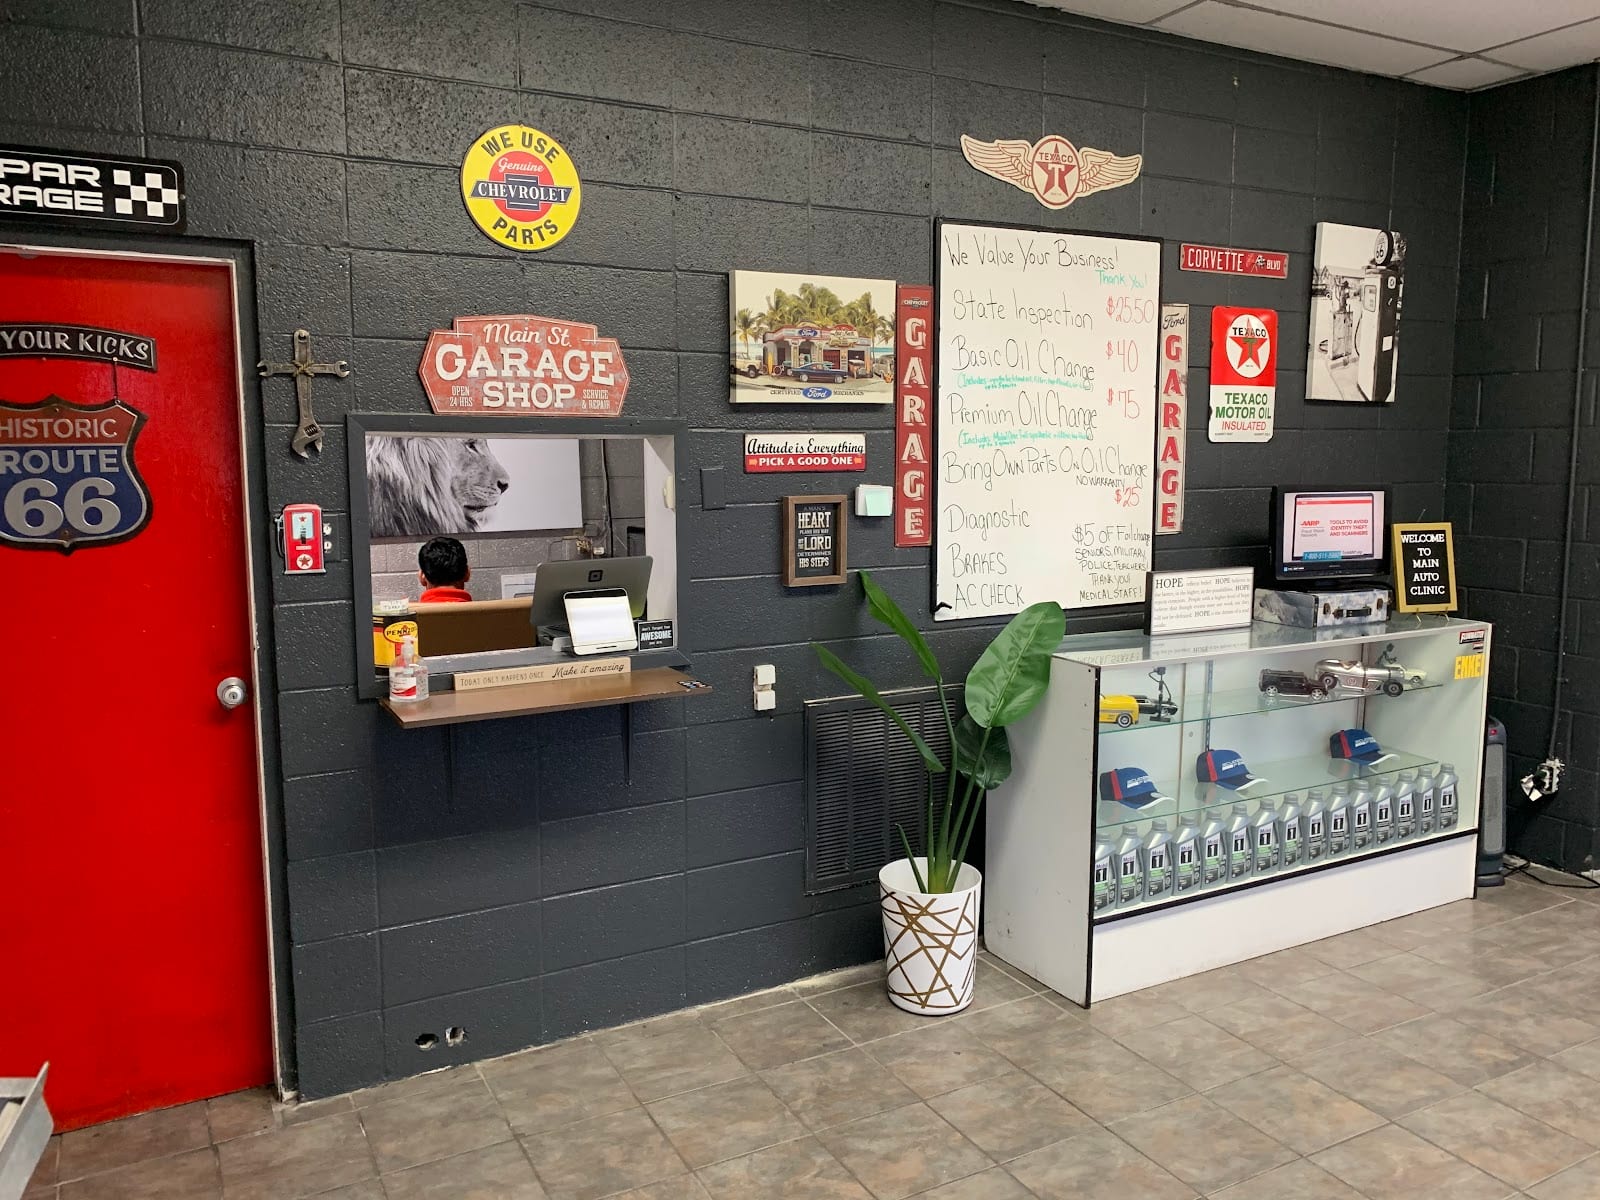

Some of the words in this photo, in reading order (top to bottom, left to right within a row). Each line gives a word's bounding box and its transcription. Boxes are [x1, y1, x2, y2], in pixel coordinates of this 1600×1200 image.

[481, 131, 514, 157] WE
[521, 131, 560, 164] USE
[498, 157, 545, 173] Genuine
[1039, 152, 1074, 163] TEXACO
[478, 182, 567, 202] CHEVROLET
[492, 216, 559, 245] PARTS
[945, 233, 969, 267] We
[973, 233, 1014, 265] Value
[1017, 237, 1050, 272] Your
[1053, 238, 1119, 270] Business!
[1188, 248, 1244, 272] CORVETTE
[1266, 260, 1281, 271] BLVD
[1095, 269, 1125, 286] Thank
[953, 289, 1005, 321] State
[1012, 288, 1093, 334] Inspection
[1163, 312, 1186, 330] Ford
[483, 323, 542, 345] Main
[548, 327, 573, 348] St.
[1232, 327, 1267, 338] TEXACO
[0, 331, 71, 350] YOUR
[79, 333, 150, 360] KICKS
[435, 343, 615, 386] GARAGE
[951, 334, 1002, 371] Basic
[1005, 338, 1030, 371] Oil
[1038, 339, 1095, 391] Change
[451, 385, 470, 396] OPEN
[482, 380, 576, 409] SHOP
[582, 389, 609, 400] SERVICE
[806, 387, 828, 399] Ford
[1224, 392, 1268, 405] TEXACO
[947, 392, 1014, 426] Premium
[1018, 390, 1042, 427] Oil
[1045, 389, 1098, 441] Change
[1215, 406, 1256, 419] MOTOR
[1258, 407, 1272, 419] OIL
[0, 418, 118, 439] HISTORIC
[901, 317, 929, 538] GARAGE
[1160, 334, 1183, 529] GARAGE
[1221, 421, 1267, 431] INSULATED
[748, 438, 793, 454] Attitude
[795, 443, 804, 454] is
[807, 438, 864, 454] Everything
[0, 450, 120, 474] ROUTE
[759, 457, 784, 467] PICK
[786, 457, 795, 466] A
[797, 457, 829, 466] GOOD
[831, 456, 853, 465] ONE
[943, 450, 992, 491] Bring
[1020, 446, 1058, 475] Parts
[1081, 446, 1103, 474] Oil
[1105, 444, 1148, 489] Change
[1075, 475, 1089, 486] NO
[1089, 477, 1126, 491] WARRANTY
[1114, 486, 1140, 507] $25
[4, 477, 121, 536] 66
[797, 511, 832, 529] HEART
[944, 499, 1030, 541] Diagnostic
[804, 535, 832, 550] LORD
[1072, 523, 1095, 547] $5
[1400, 533, 1445, 544] WELCOME
[946, 542, 1008, 578] BRAKES
[1417, 547, 1432, 557] TO
[798, 557, 810, 568] HIS
[810, 557, 830, 567] STEPS
[1412, 558, 1440, 568] MAIN
[1155, 577, 1184, 589] HOPE
[1412, 572, 1440, 582] AUTO
[955, 583, 977, 612] AC
[980, 583, 1025, 608] CHECK
[1079, 589, 1113, 602] MEDICAL
[1410, 585, 1446, 595] CLINIC
[640, 630, 672, 641] AWESOME
[460, 678, 481, 687] TODAY
[482, 676, 500, 685] ONLY
[551, 666, 578, 679] Make
[580, 665, 588, 674] it
[589, 662, 625, 674] amazing
